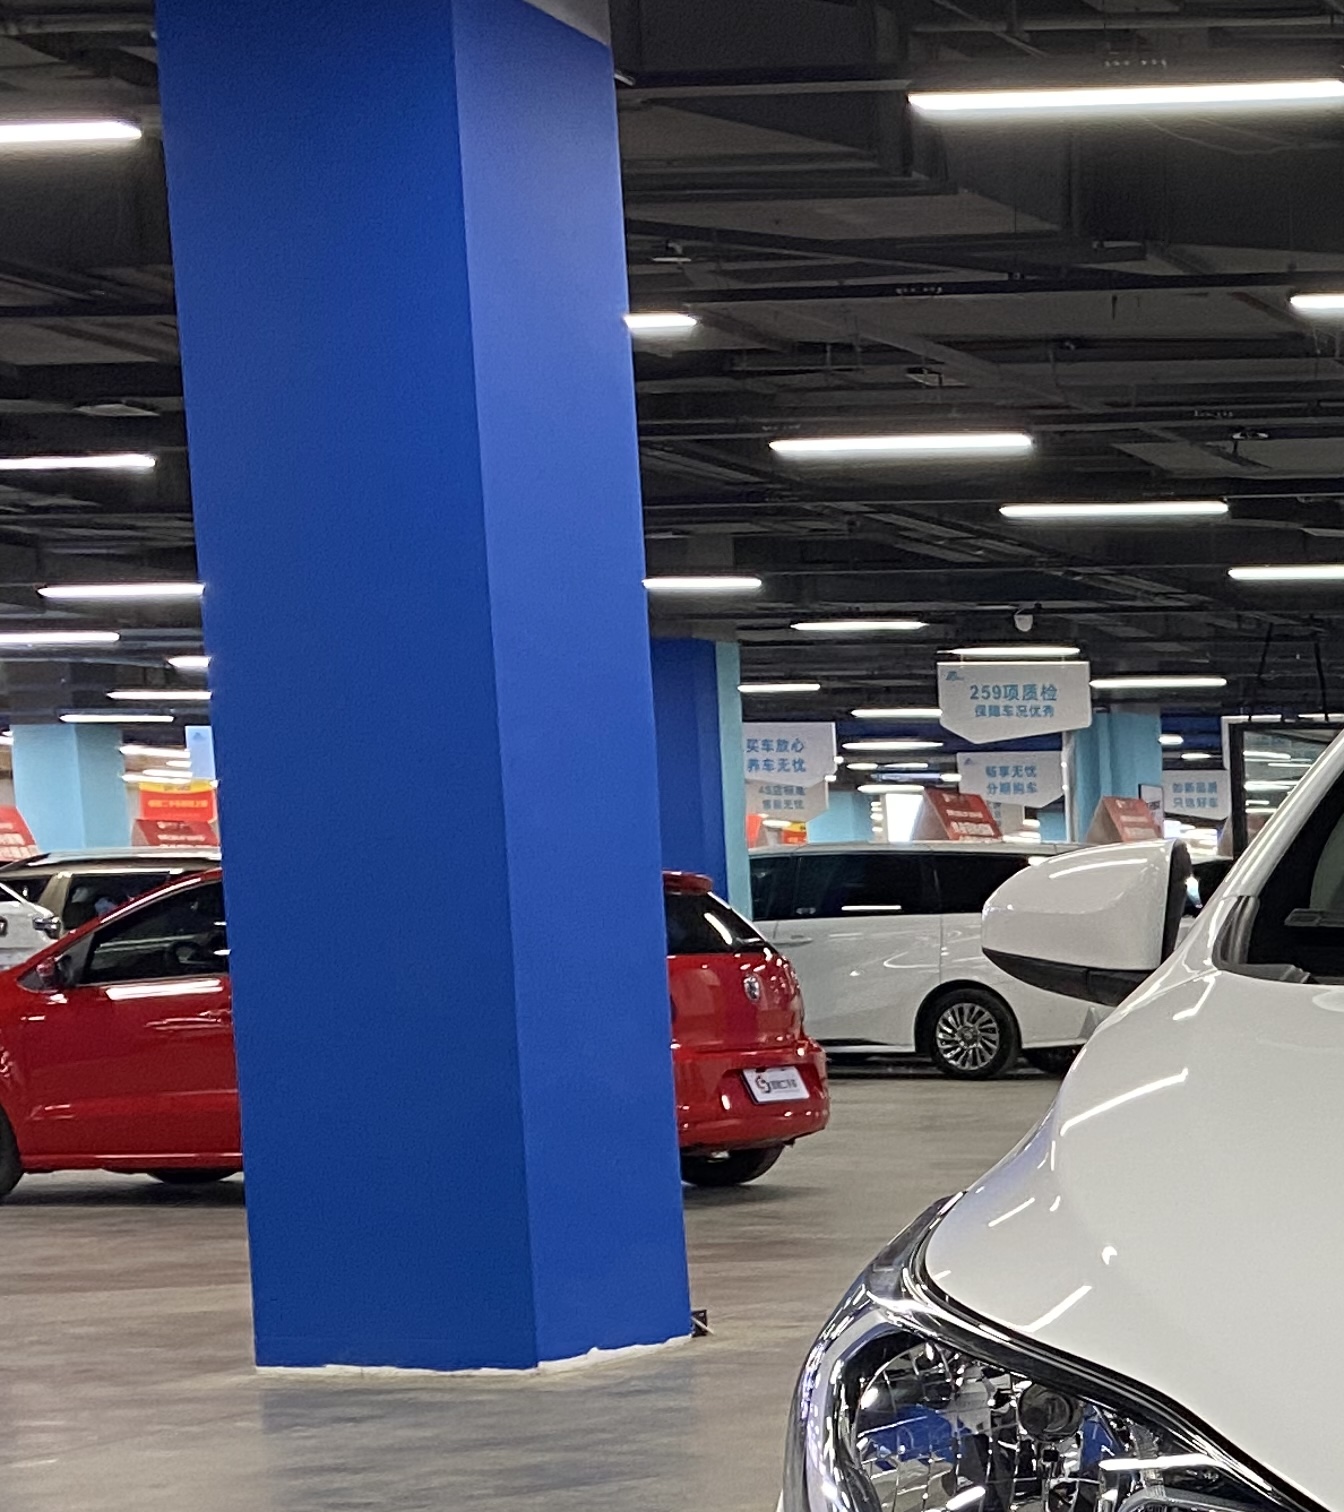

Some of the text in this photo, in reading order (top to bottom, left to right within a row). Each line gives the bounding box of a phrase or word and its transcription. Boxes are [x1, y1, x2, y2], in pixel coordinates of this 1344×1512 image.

[969, 684, 1058, 701] 259项质检
[746, 738, 805, 753] 买车放心
[747, 758, 807, 773] 养车无忧
